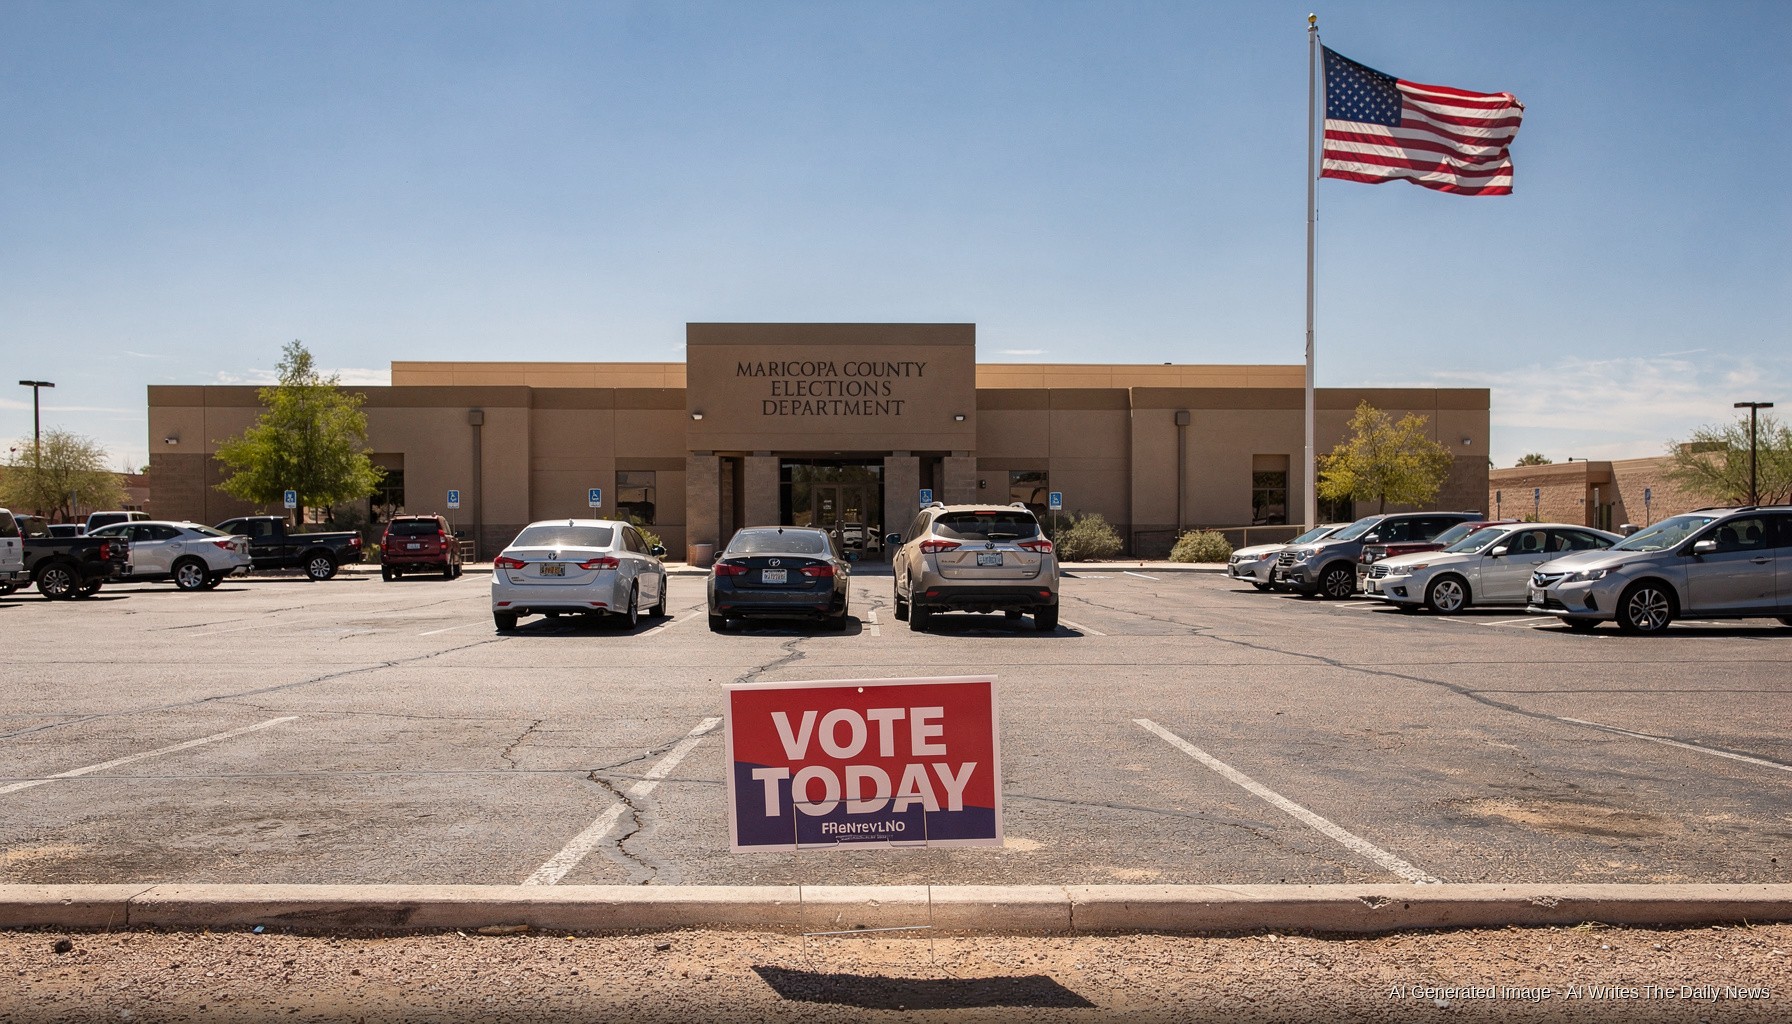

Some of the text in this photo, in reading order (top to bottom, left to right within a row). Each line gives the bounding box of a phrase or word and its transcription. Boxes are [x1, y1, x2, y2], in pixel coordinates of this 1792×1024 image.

[736, 361, 927, 377] MARICOPA COUNTY
[771, 380, 892, 397] ELECTIONS
[762, 399, 905, 416] DEPARTMENT
[771, 706, 947, 761] VOTE
[752, 761, 978, 818] TODAY
